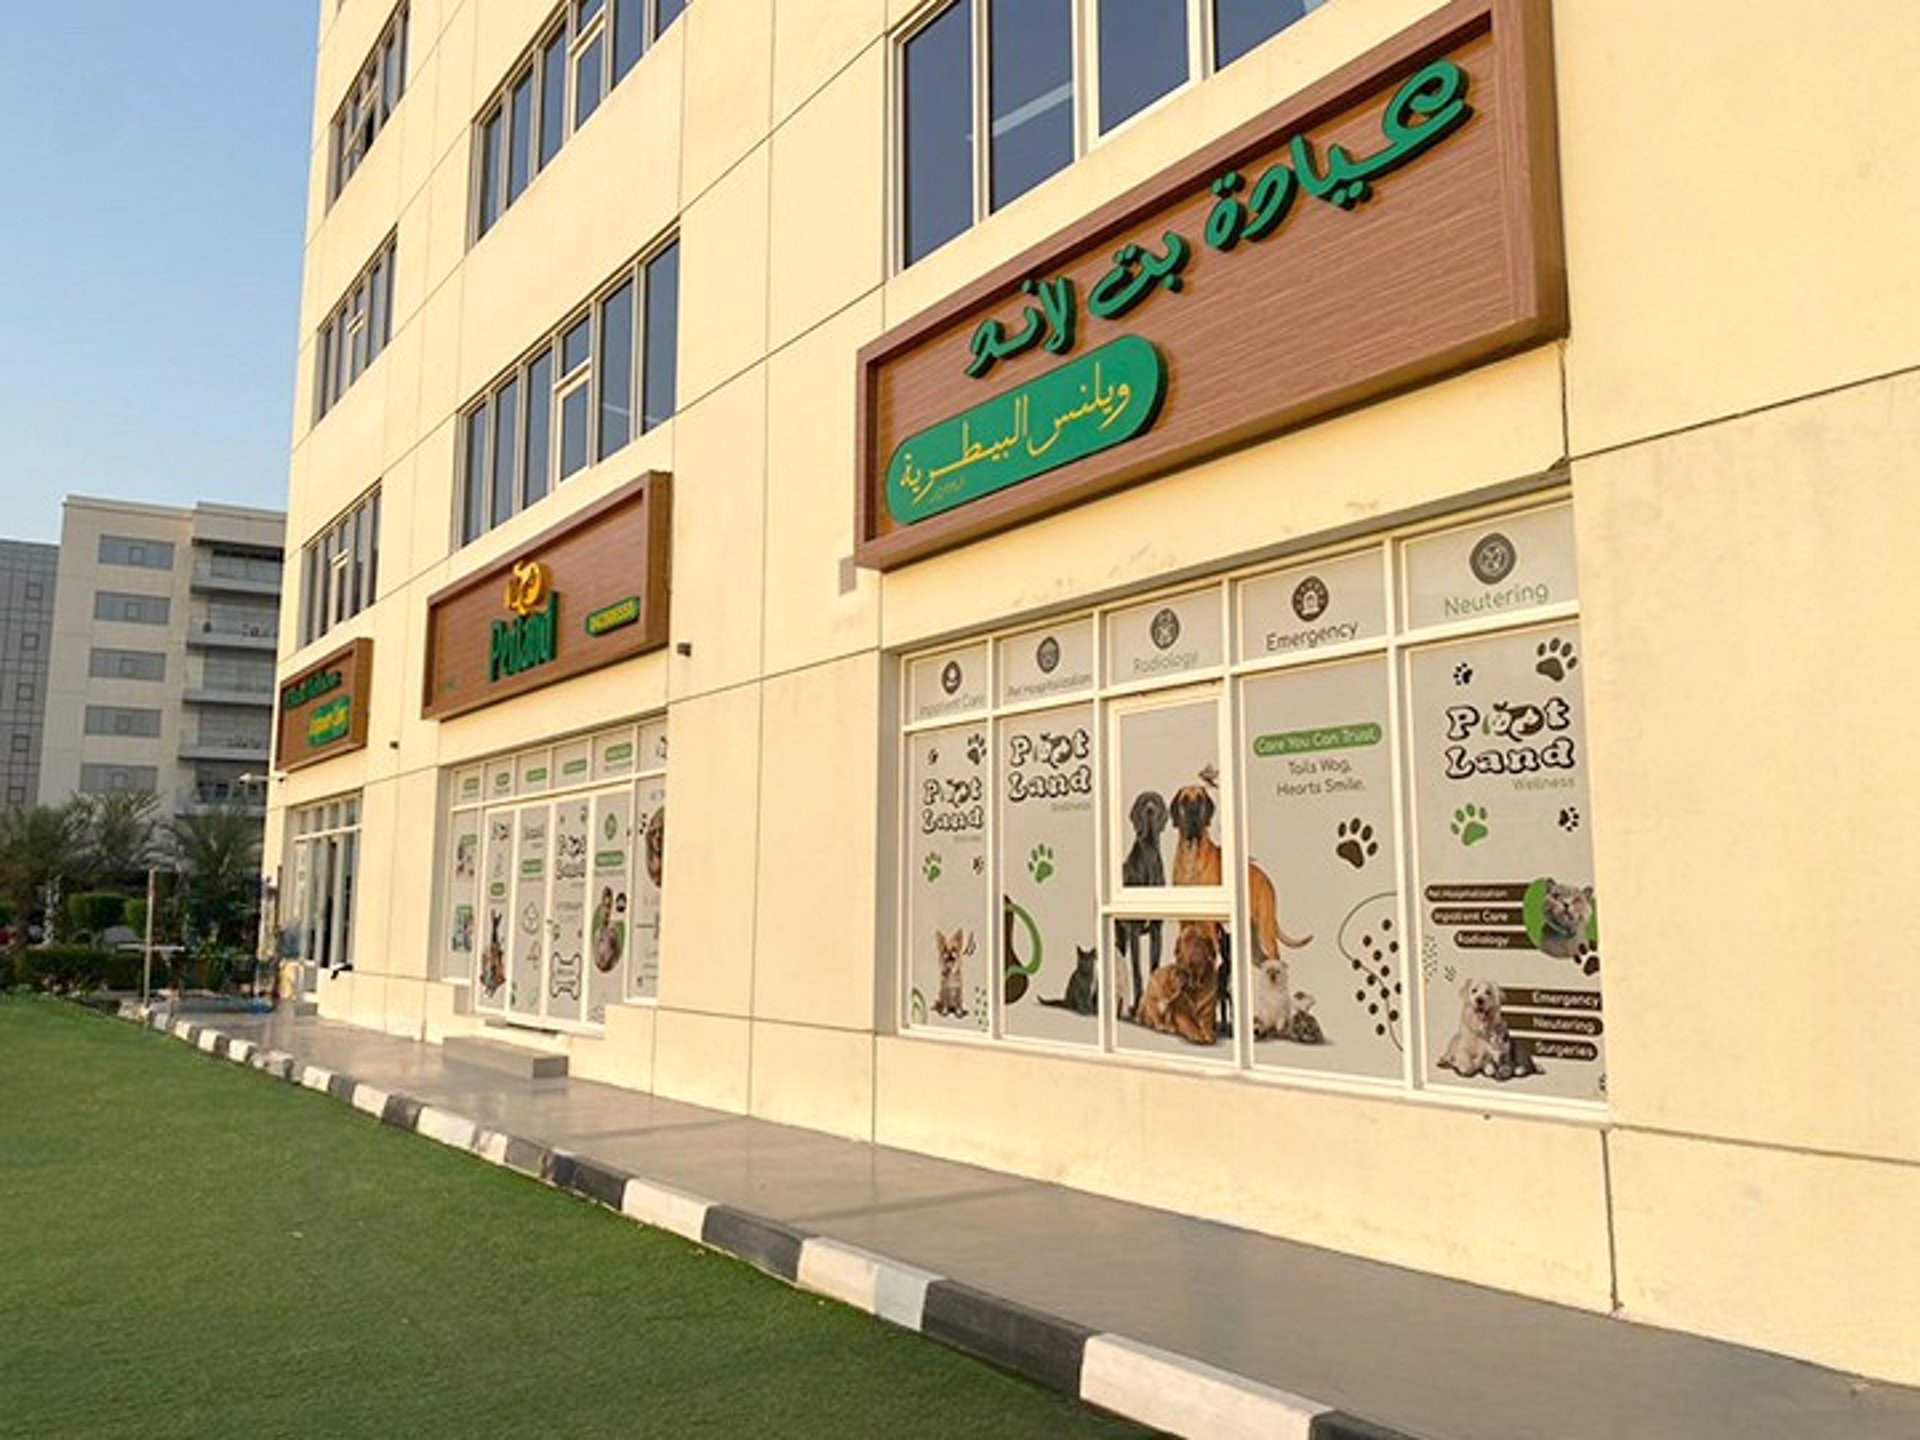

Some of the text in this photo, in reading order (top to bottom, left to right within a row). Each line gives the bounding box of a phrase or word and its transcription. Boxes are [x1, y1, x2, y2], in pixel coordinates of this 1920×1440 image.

[1204, 58, 1470, 252] عيادة
[1088, 230, 1186, 319] بت
[900, 393, 1029, 507] البيطرية
[1443, 583, 1549, 617] Neutering
[1265, 622, 1358, 651] Emergency
[1133, 651, 1198, 676] Radiology
[1257, 736, 1285, 753] Care
[1287, 734, 1311, 750] You
[1312, 732, 1340, 747] Can
[1288, 760, 1318, 775] Tails
[1445, 736, 1575, 779] Land
[1008, 765, 1092, 802] Land
[1276, 781, 1322, 797] Hearts
[922, 805, 984, 834] Land
[1482, 909, 1509, 923] Care
[1457, 932, 1510, 948] Radiology
[1532, 991, 1599, 1010] Emergency
[1532, 1016, 1596, 1035] Neutering
[1535, 1041, 1594, 1057] Surgeries
